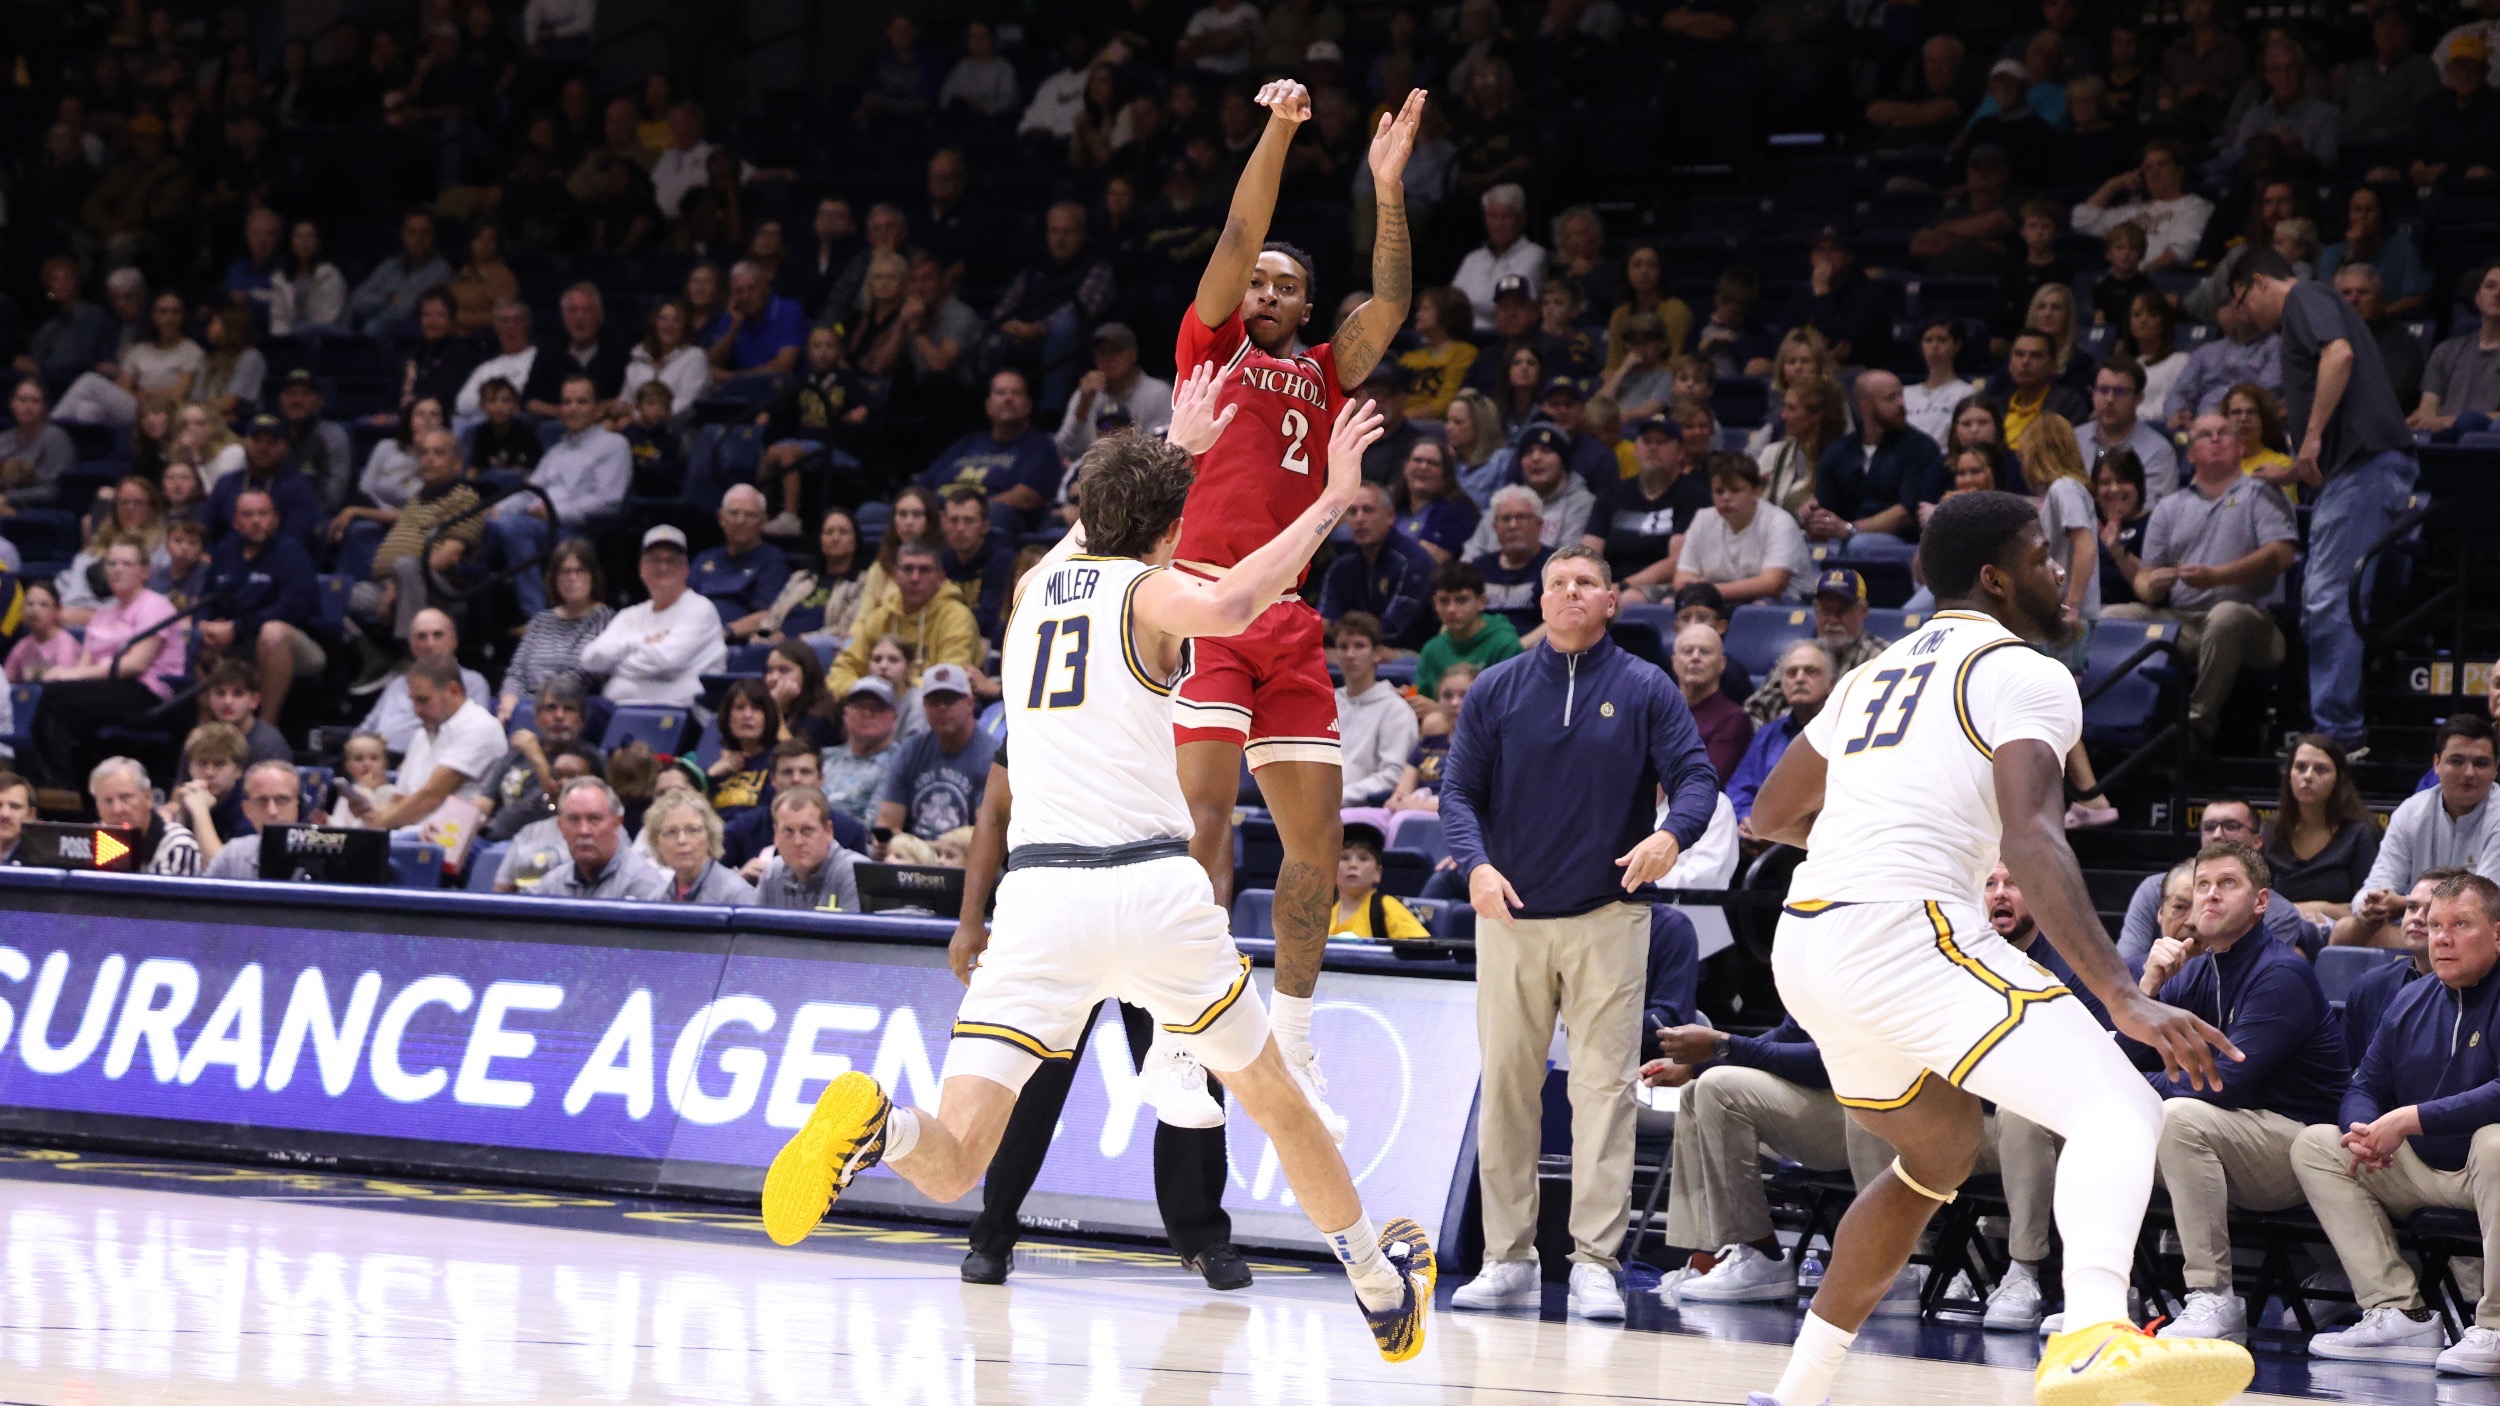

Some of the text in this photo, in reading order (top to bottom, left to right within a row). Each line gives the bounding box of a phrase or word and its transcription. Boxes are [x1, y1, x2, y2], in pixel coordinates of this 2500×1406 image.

[1280, 408, 1309, 475] 2
[1044, 568, 1100, 606] MILLER
[1025, 612, 1090, 711] 13
[2410, 666, 2430, 691] G
[1843, 660, 1937, 757] 33
[2150, 802, 2168, 827] F
[563, 986, 1142, 1159] AGENY
